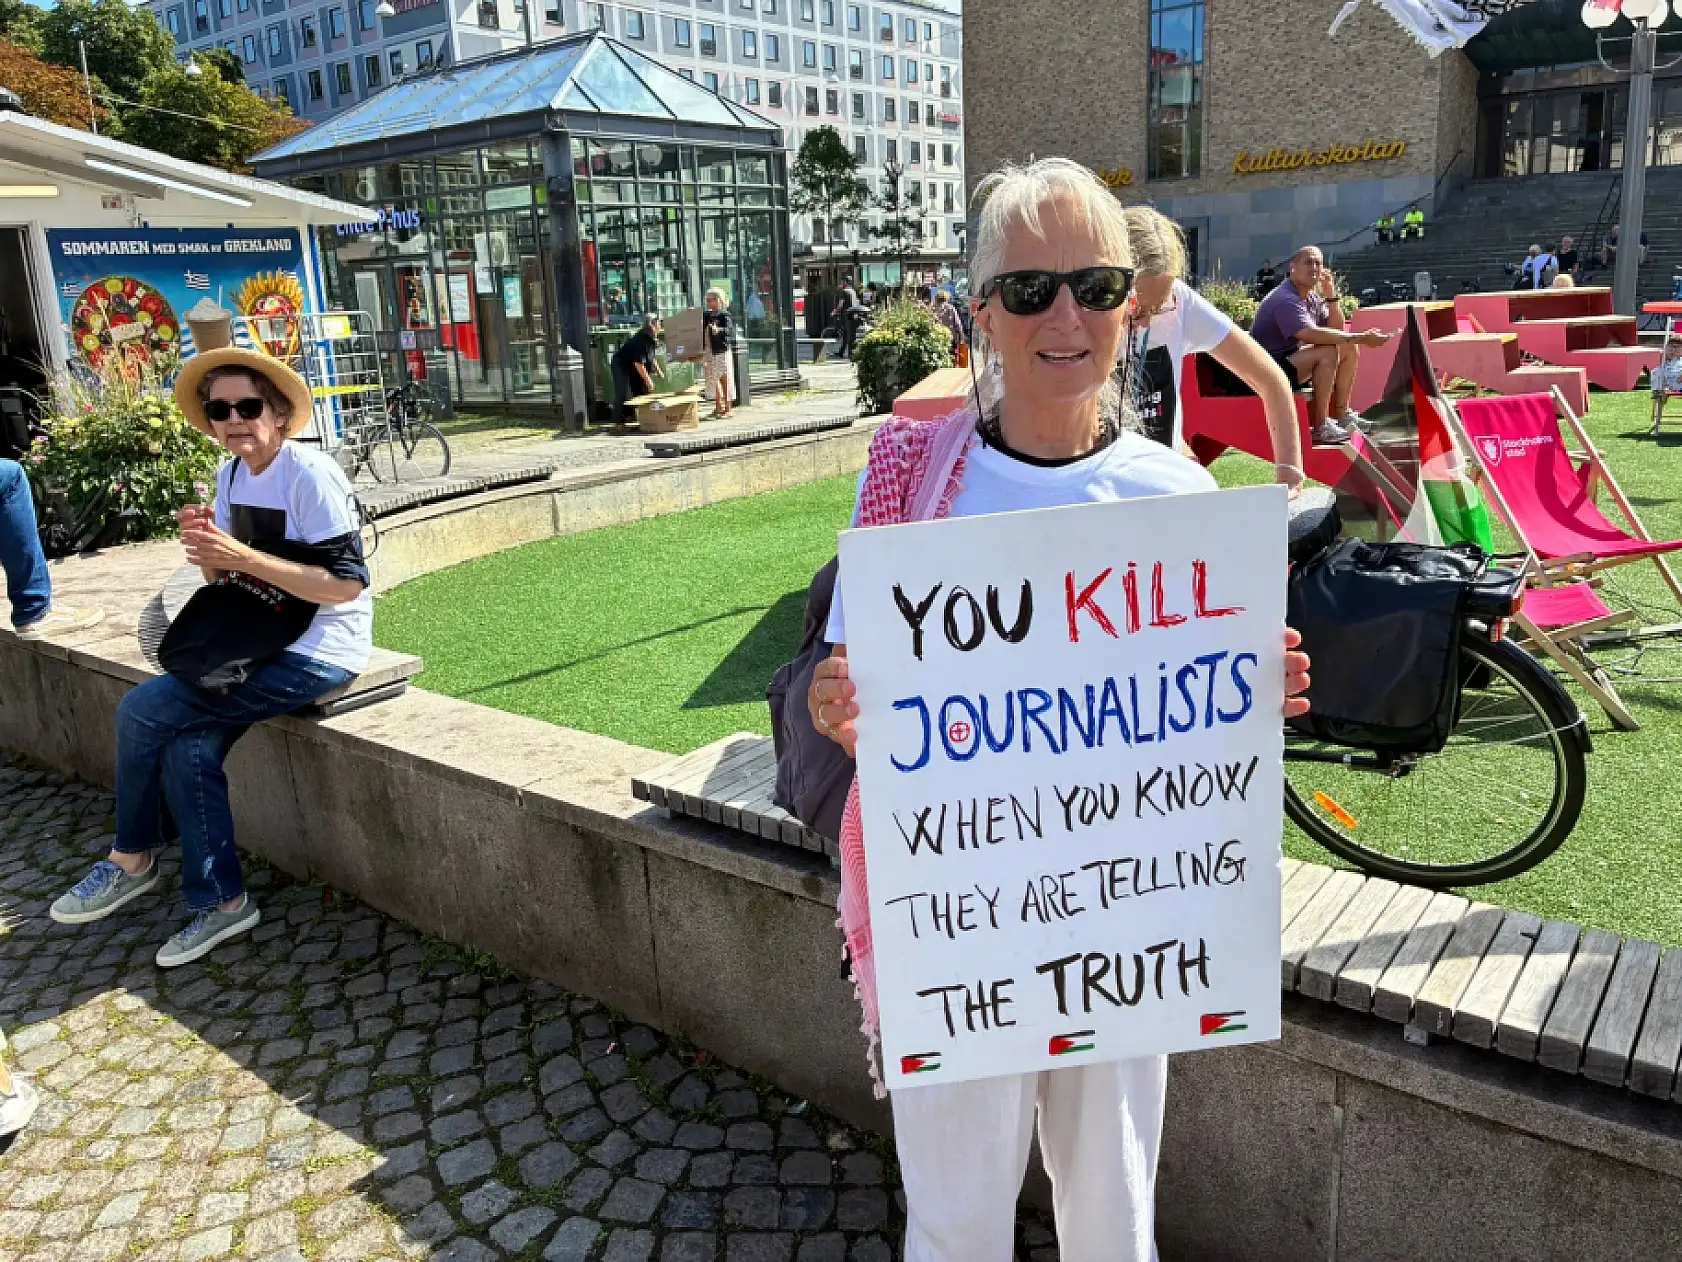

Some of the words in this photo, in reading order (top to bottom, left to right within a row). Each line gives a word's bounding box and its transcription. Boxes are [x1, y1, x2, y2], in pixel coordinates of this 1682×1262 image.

[1233, 139, 1406, 174] Kulturskolan
[61, 240, 149, 255] SOMMAREN
[152, 243, 176, 254] MED
[223, 239, 292, 253] GREKLAND
[376, 204, 420, 230] P-hus
[892, 578, 1034, 662] YOU
[892, 787, 1043, 856] WHEN
[1053, 782, 1120, 832] YOU
[1135, 755, 1260, 818] KNOW
[885, 884, 1000, 939] THEY
[1020, 871, 1086, 924] ARE
[1081, 839, 1247, 910] TELLING
[916, 978, 1017, 1037] THE
[1035, 937, 1212, 1016] TRUTH
